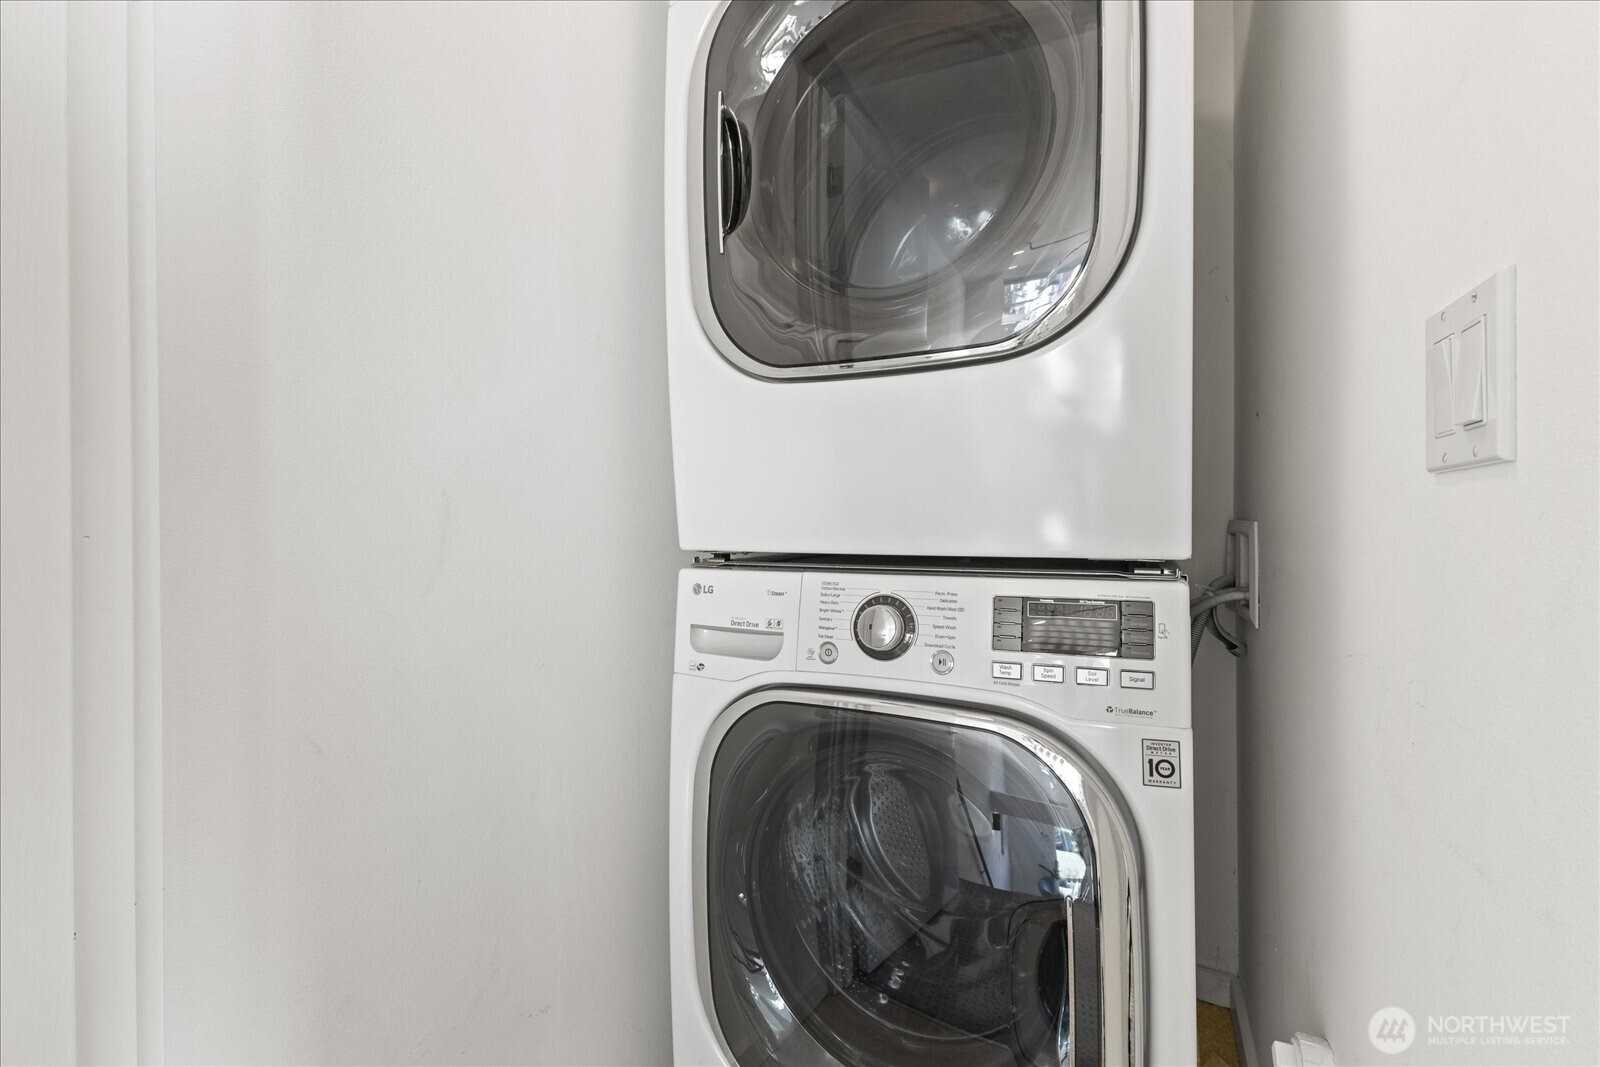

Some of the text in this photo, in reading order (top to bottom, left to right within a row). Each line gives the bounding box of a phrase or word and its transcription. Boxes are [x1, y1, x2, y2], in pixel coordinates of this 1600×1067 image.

[703, 585, 714, 594] LG
[730, 619, 760, 628] Direct Drive
[1114, 706, 1154, 716] TrueBalance
[1147, 758, 1176, 779] 10
